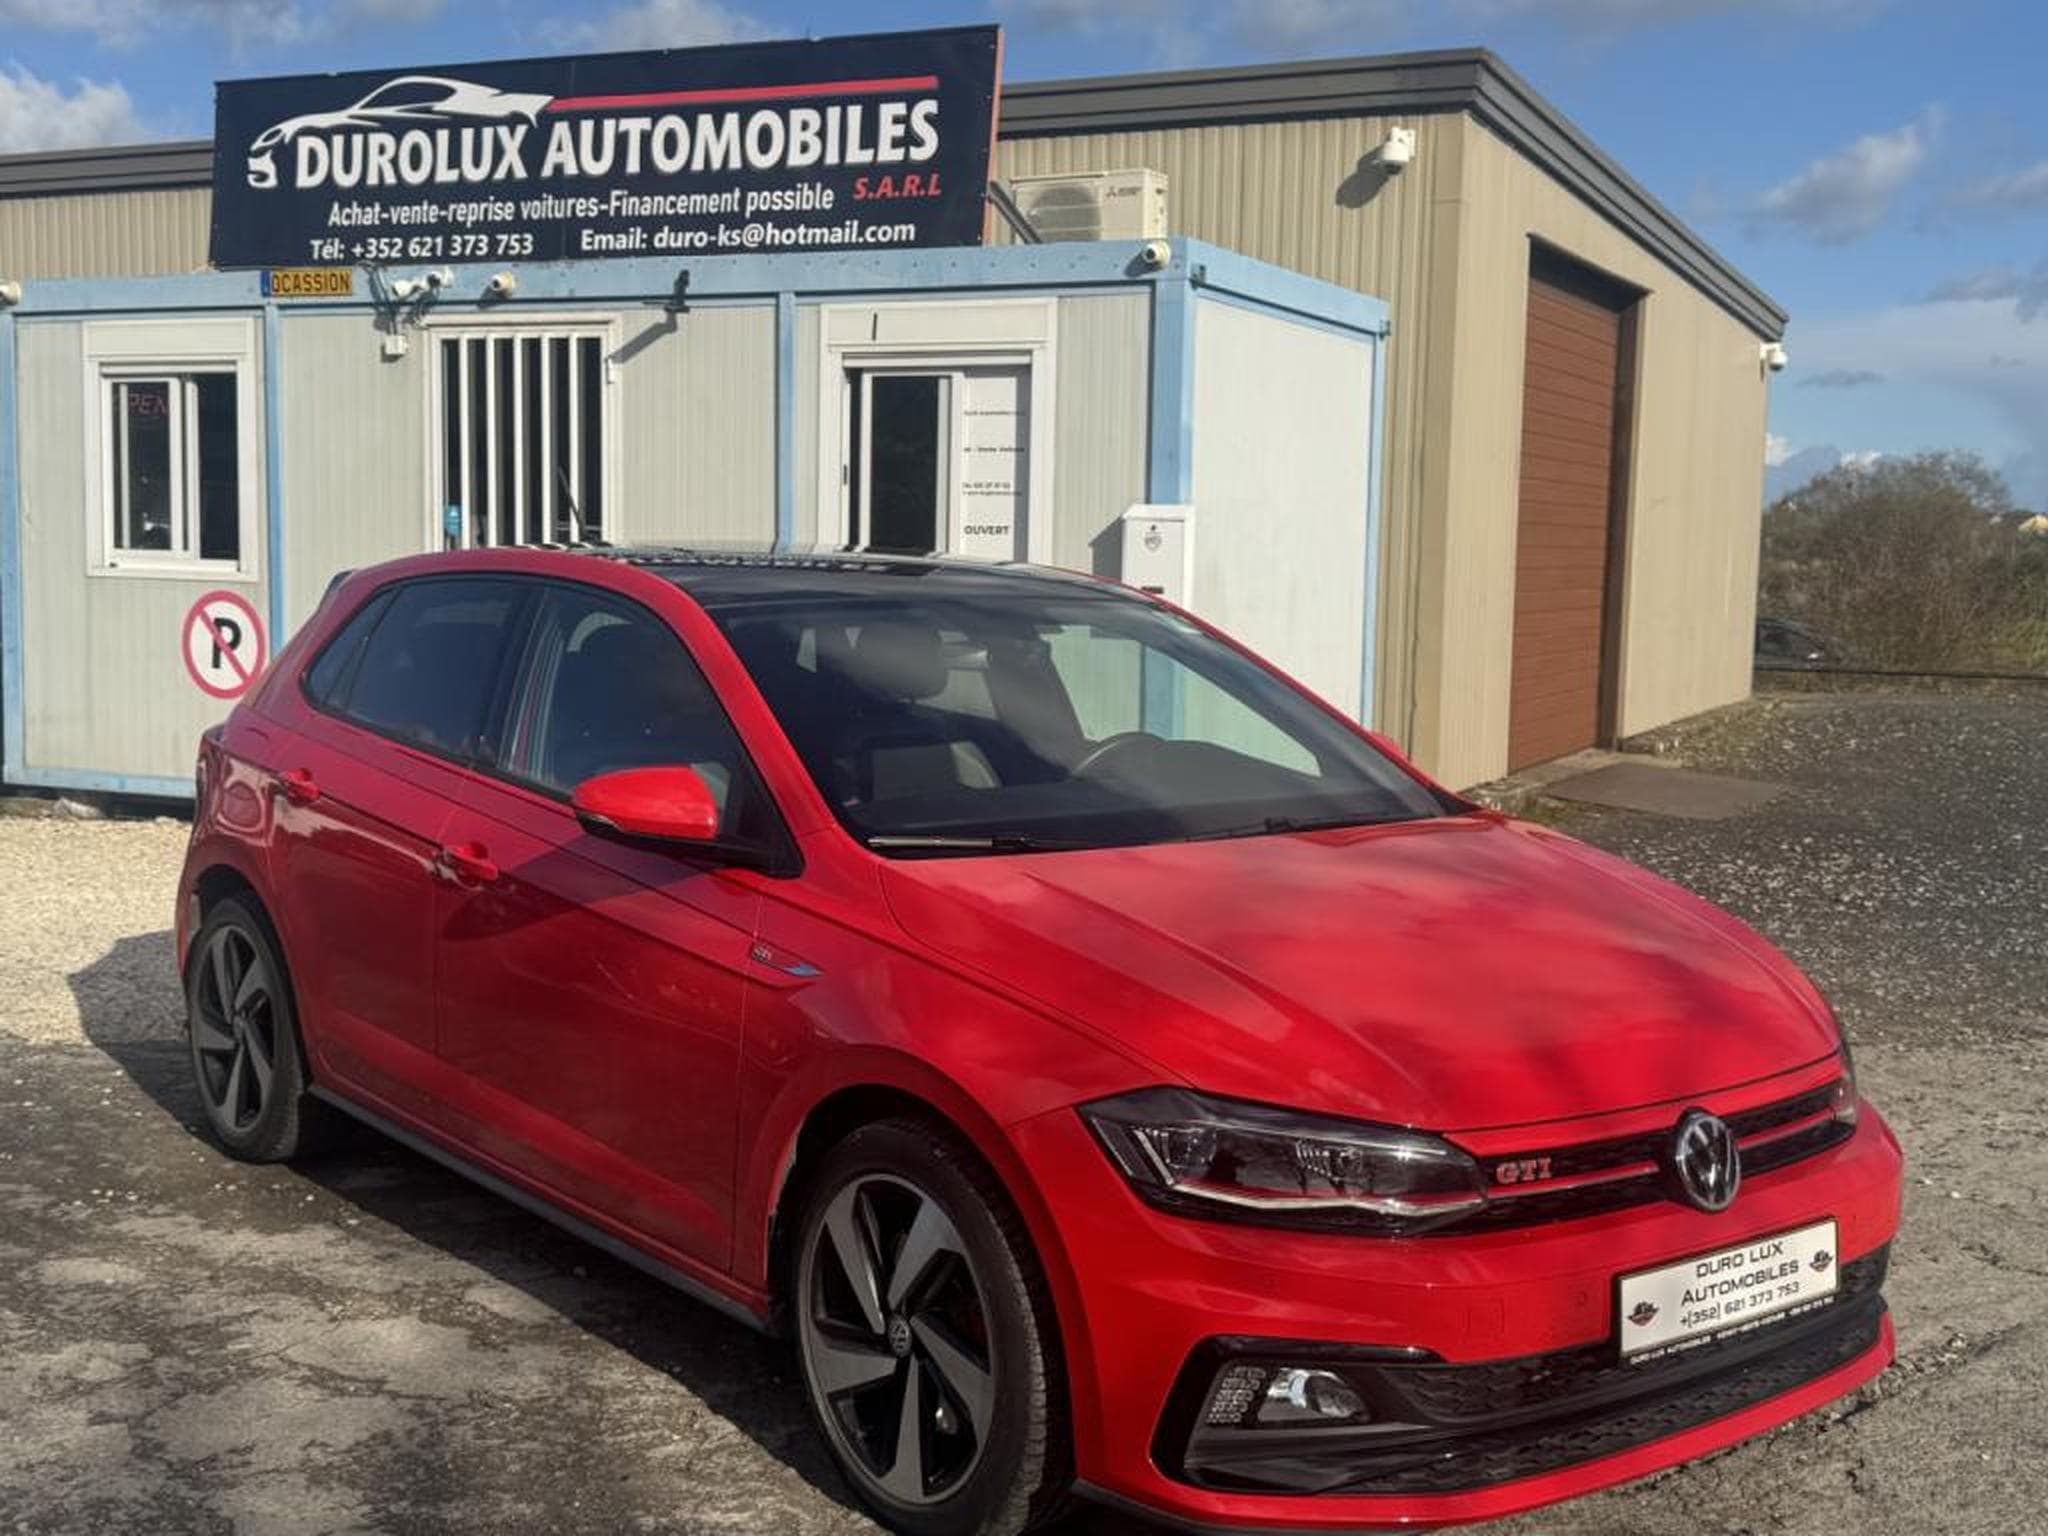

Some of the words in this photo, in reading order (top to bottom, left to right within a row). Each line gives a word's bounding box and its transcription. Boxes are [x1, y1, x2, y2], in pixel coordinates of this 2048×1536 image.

[296, 124, 528, 188] DUROLUX
[541, 99, 940, 179] AUTOMOBILES
[853, 173, 942, 200] S.A.R.L
[328, 196, 515, 228] Achat-vente-reprise
[520, 187, 740, 221] voitures-Financement
[745, 184, 834, 218] possible
[310, 238, 345, 261] Tél:
[351, 236, 403, 258] +352
[408, 235, 444, 257] 621
[450, 234, 490, 256] 373
[496, 233, 534, 255] 753
[581, 227, 647, 251] Email:
[653, 220, 916, 250] duro-ks@hotmail.com
[272, 272, 350, 293] OCASSION
[963, 525, 1009, 535] OUVERT
[211, 617, 241, 669] P
[1496, 1157, 1551, 1184] GTI
[1696, 1253, 1745, 1278] DURO
[1750, 1241, 1784, 1263] LUX
[1681, 1259, 1799, 1307] AUTOMOBILES
[1725, 1300, 1745, 1316] 621
[1749, 1289, 1773, 1307] 373
[1777, 1280, 1799, 1297] 753
